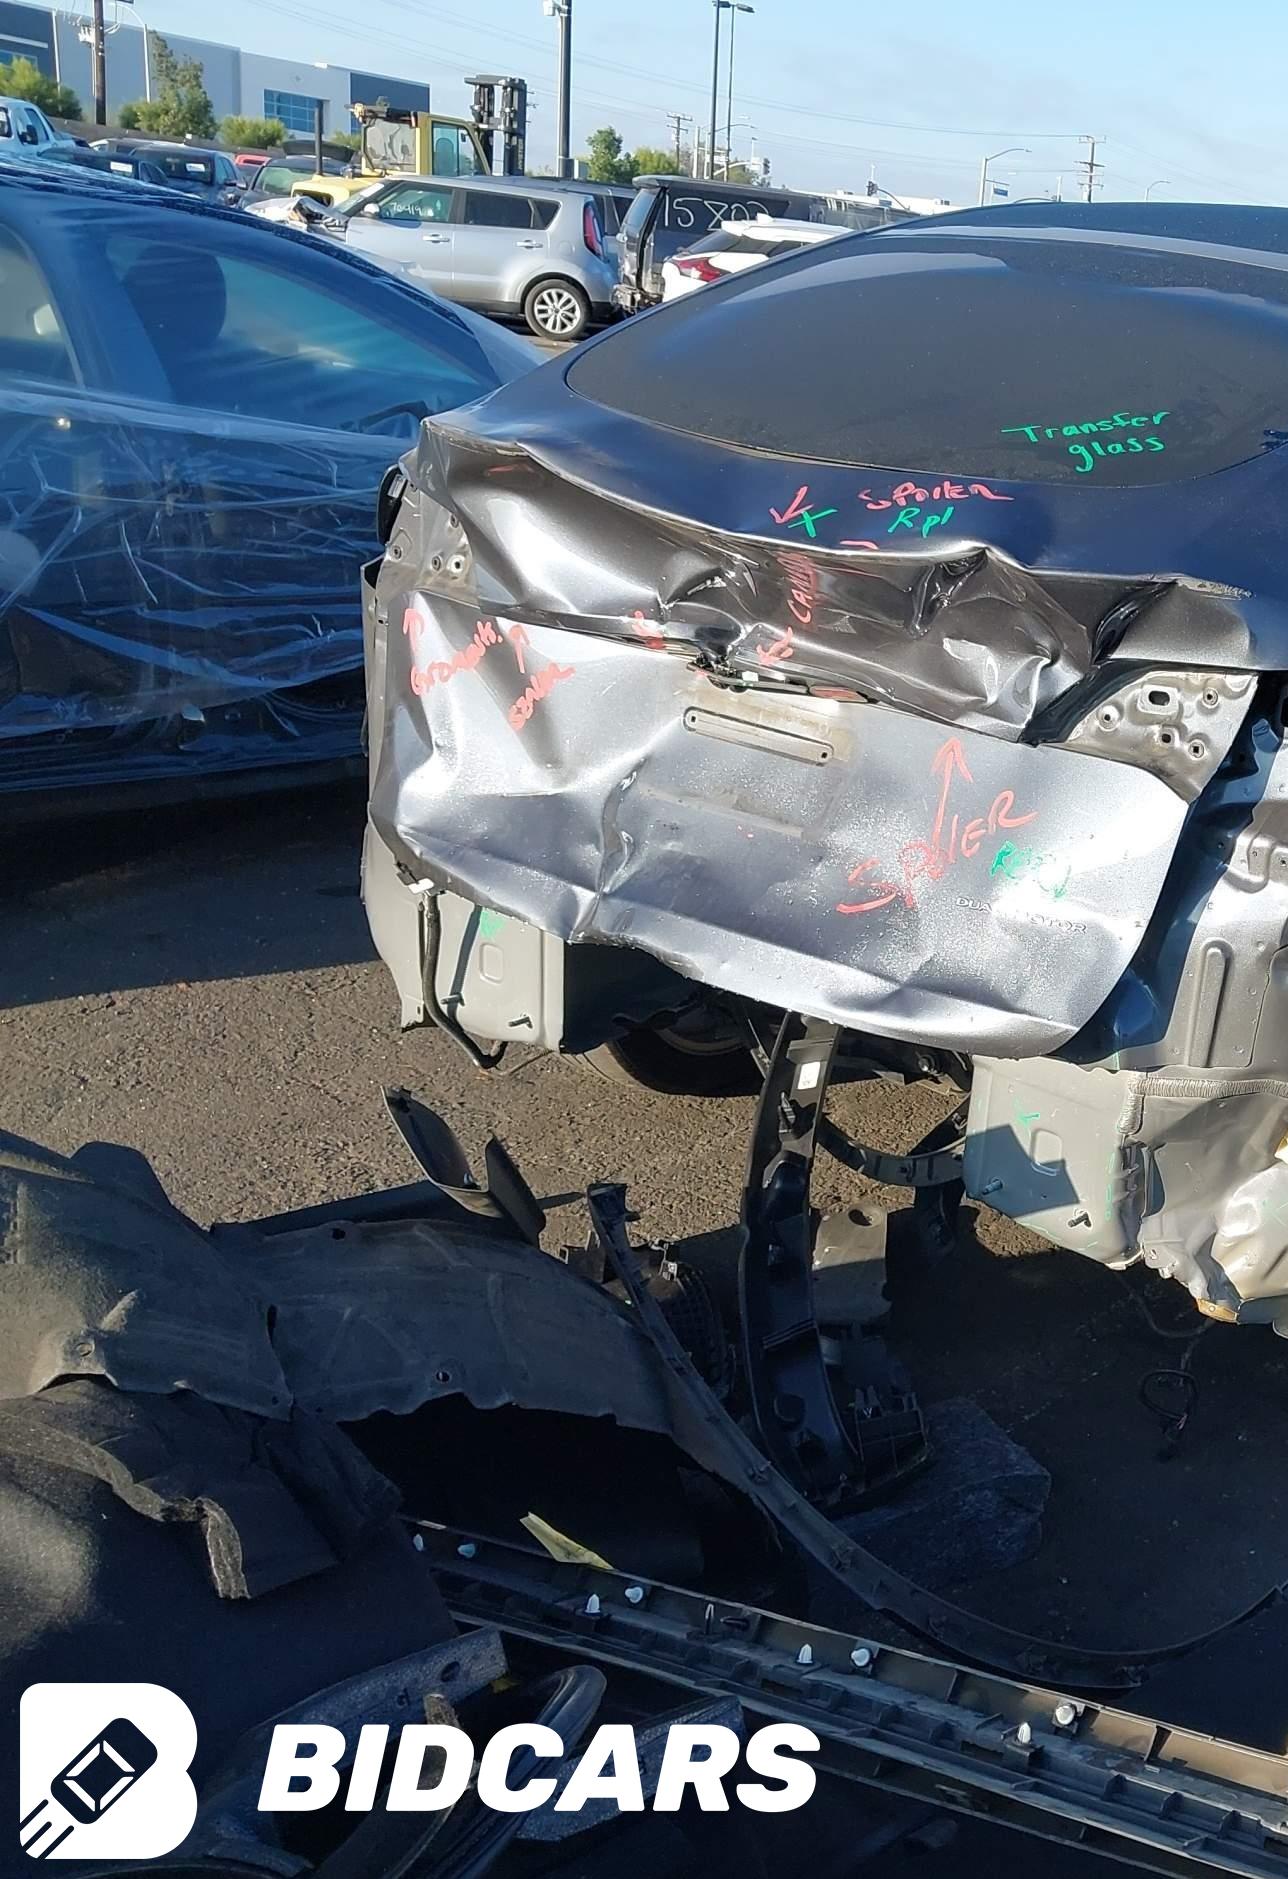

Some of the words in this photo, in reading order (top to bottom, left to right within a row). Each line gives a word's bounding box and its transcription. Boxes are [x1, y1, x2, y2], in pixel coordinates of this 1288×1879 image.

[1000, 411, 1170, 442] Transfer
[1067, 436, 1164, 473] glass
[955, 896, 1000, 916] DUA
